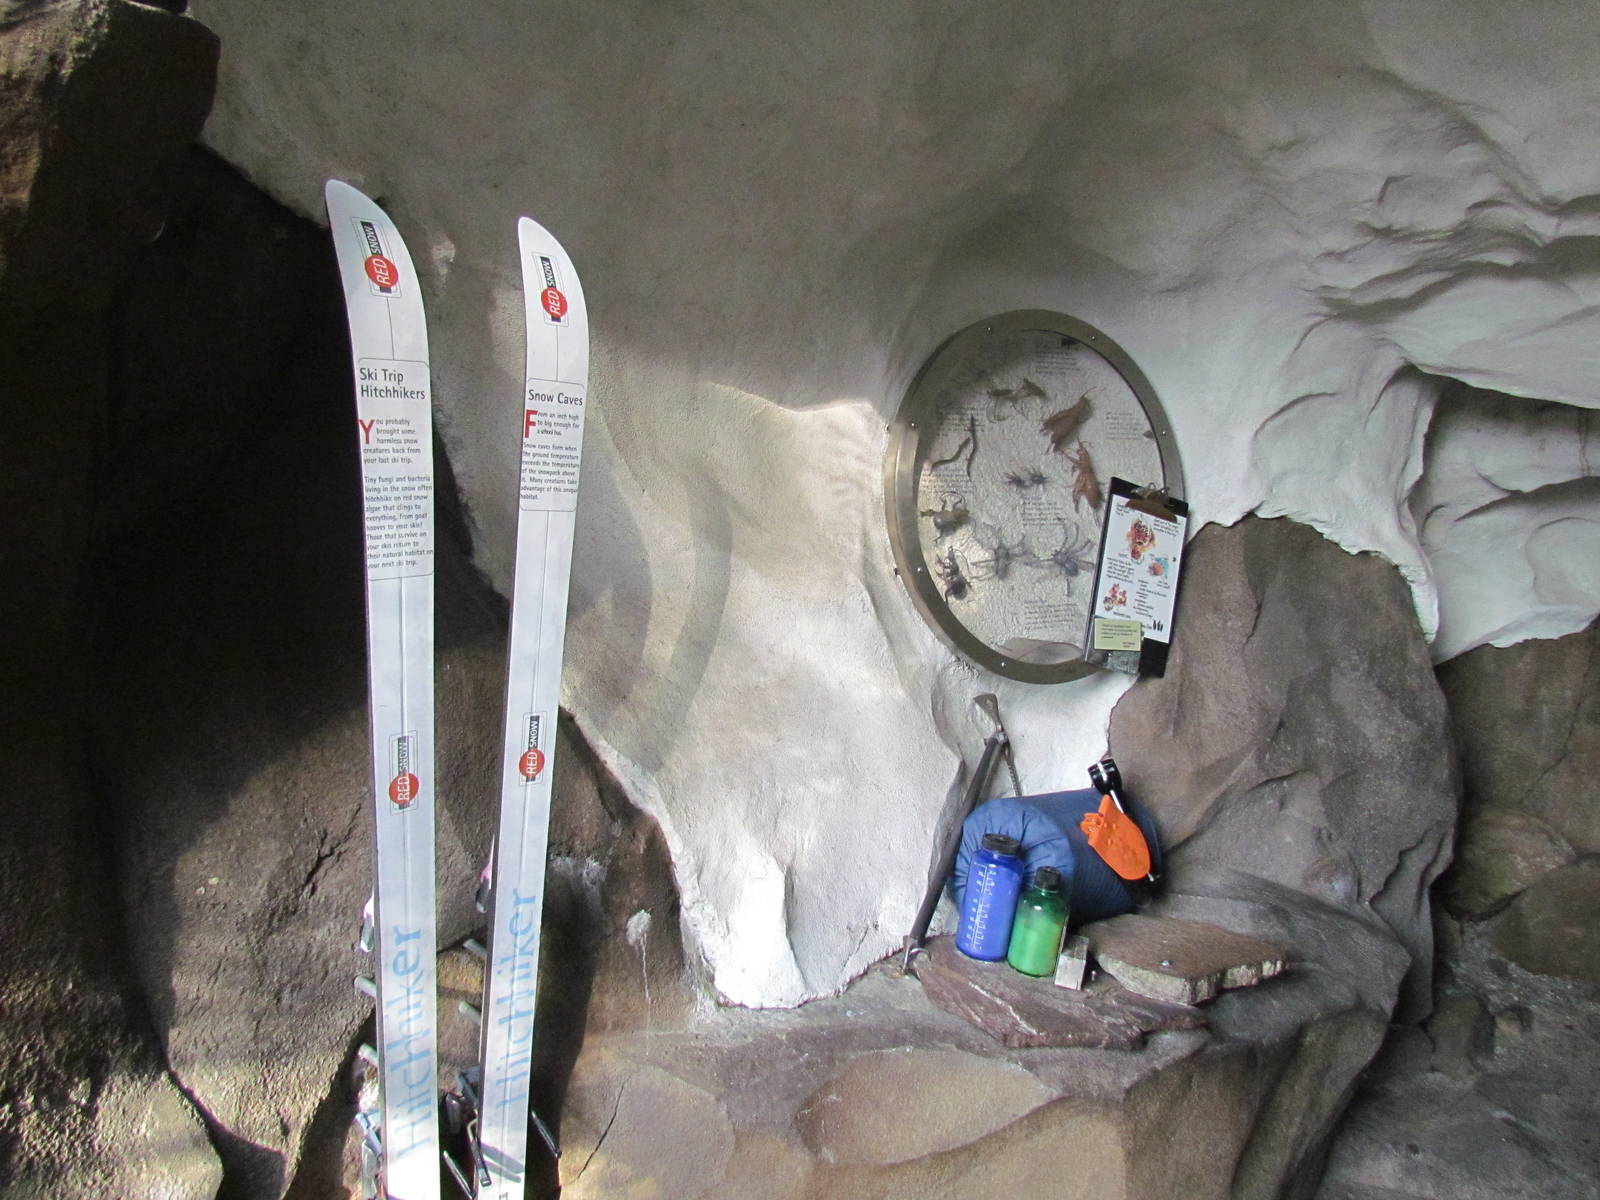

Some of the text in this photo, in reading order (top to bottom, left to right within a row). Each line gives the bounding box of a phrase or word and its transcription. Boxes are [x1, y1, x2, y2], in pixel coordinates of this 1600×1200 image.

[364, 226, 391, 285] RED SNOW
[542, 261, 560, 314] RED SNOW
[360, 368, 404, 385] Ski Trip
[361, 385, 425, 399] Hitchhikers
[529, 389, 583, 406] Snow Caves
[398, 742, 410, 800] RED SNOW
[526, 720, 538, 774] RED SNOW
